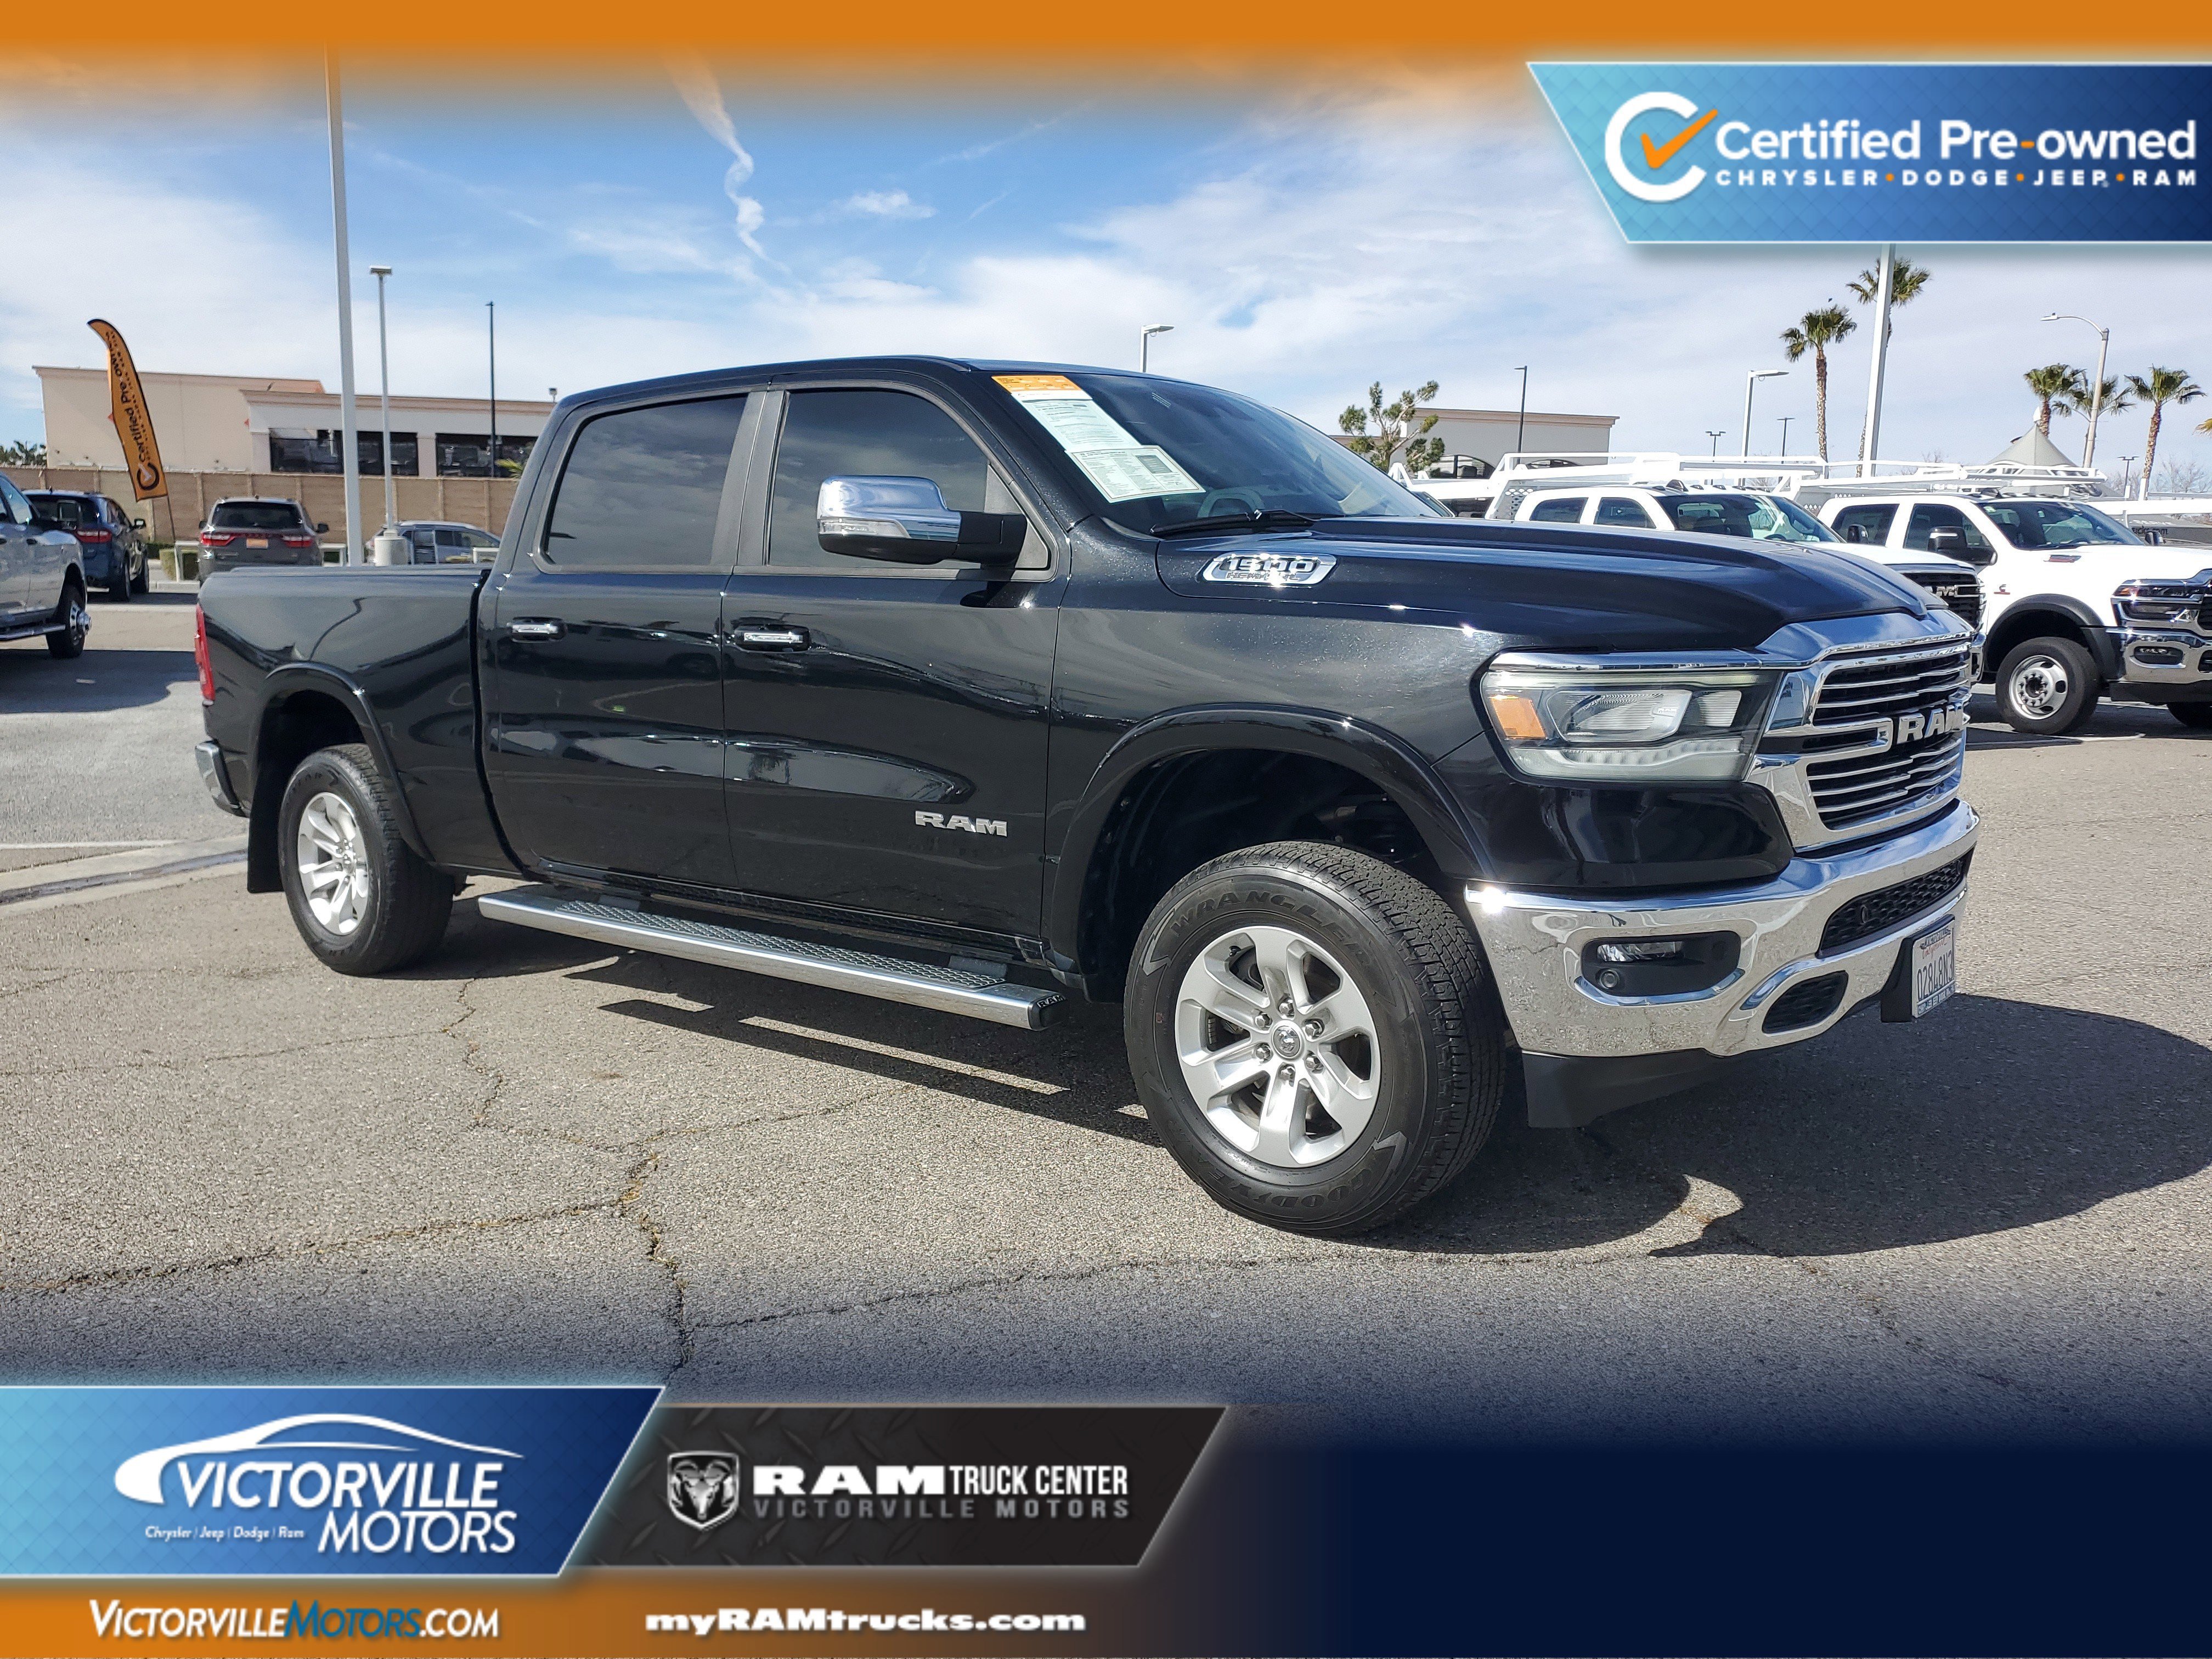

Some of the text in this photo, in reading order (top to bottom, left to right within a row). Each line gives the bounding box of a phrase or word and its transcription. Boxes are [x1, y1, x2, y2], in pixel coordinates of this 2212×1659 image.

[1227, 558, 1314, 573] 1500
[1897, 702, 1963, 744] RAM
[915, 811, 1007, 837] RAM
[1170, 890, 1372, 965] WRANGLER
